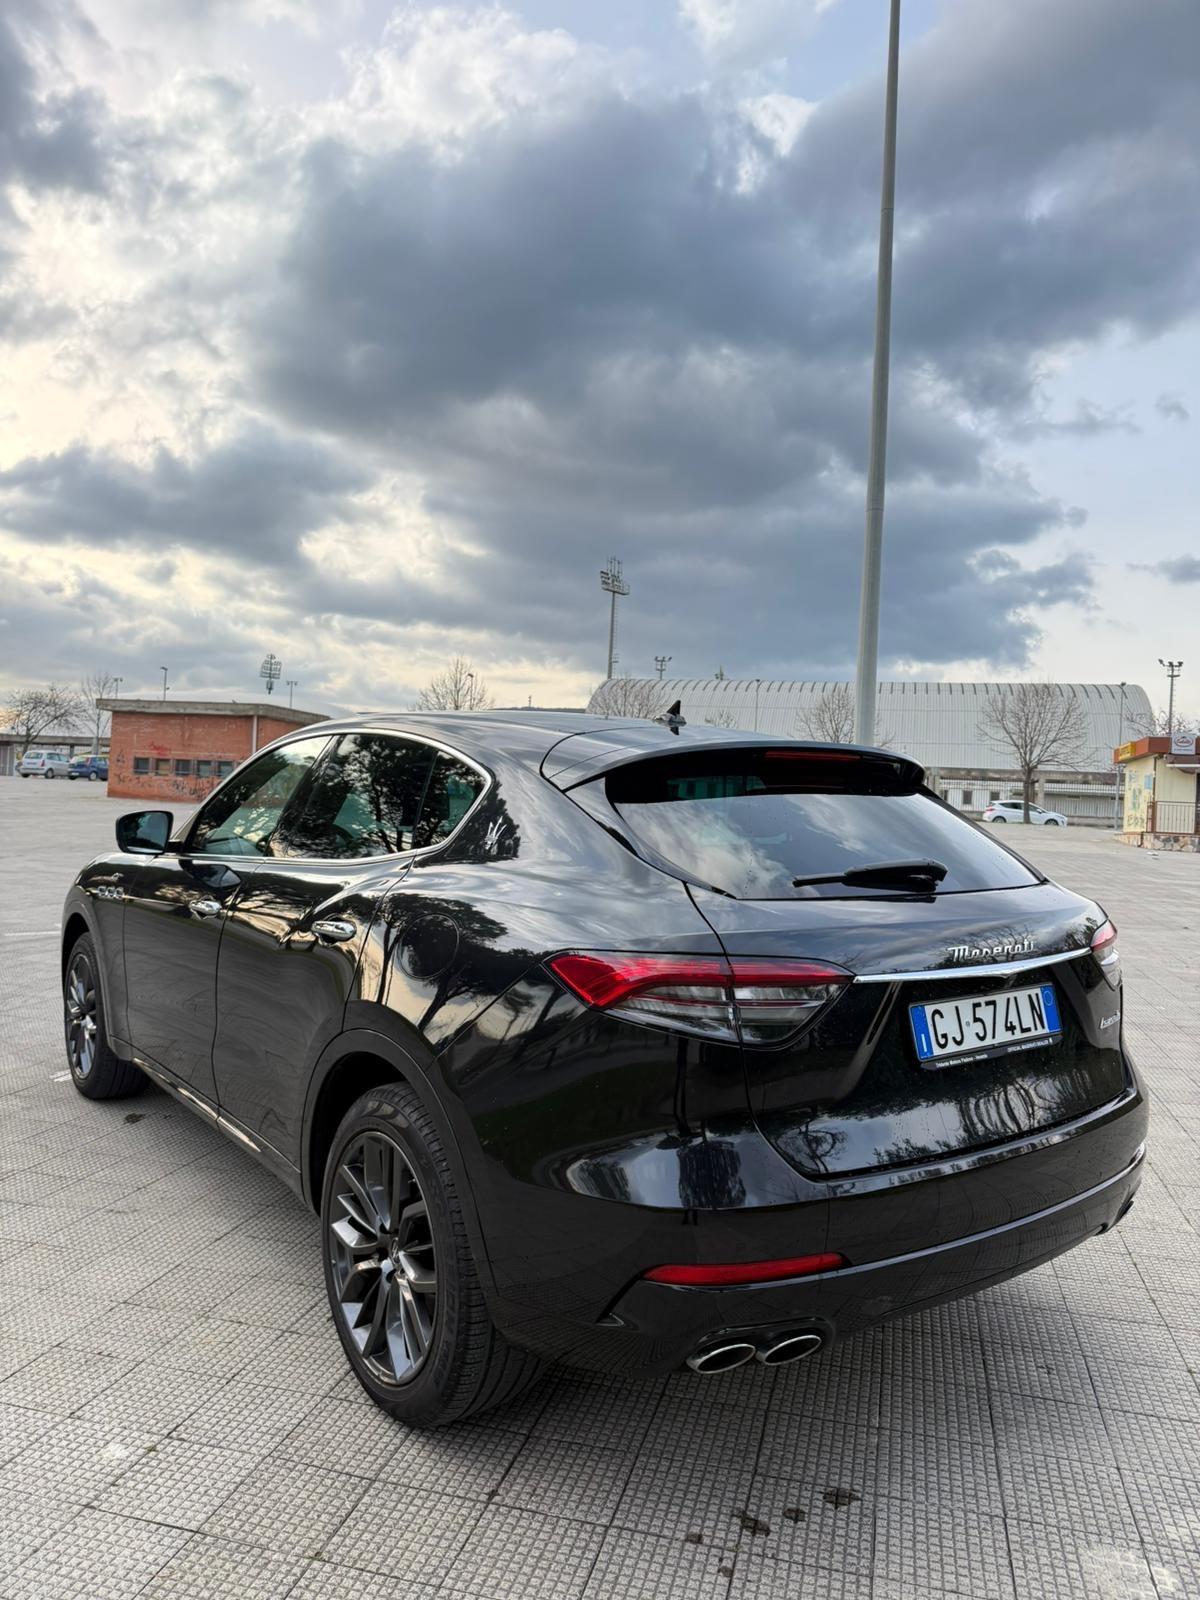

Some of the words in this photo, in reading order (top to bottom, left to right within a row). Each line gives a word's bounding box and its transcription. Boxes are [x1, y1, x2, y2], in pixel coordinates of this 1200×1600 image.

[946, 938, 1035, 962] Maserati
[930, 1005, 965, 1050] GJ
[971, 992, 1046, 1042] 574LN
